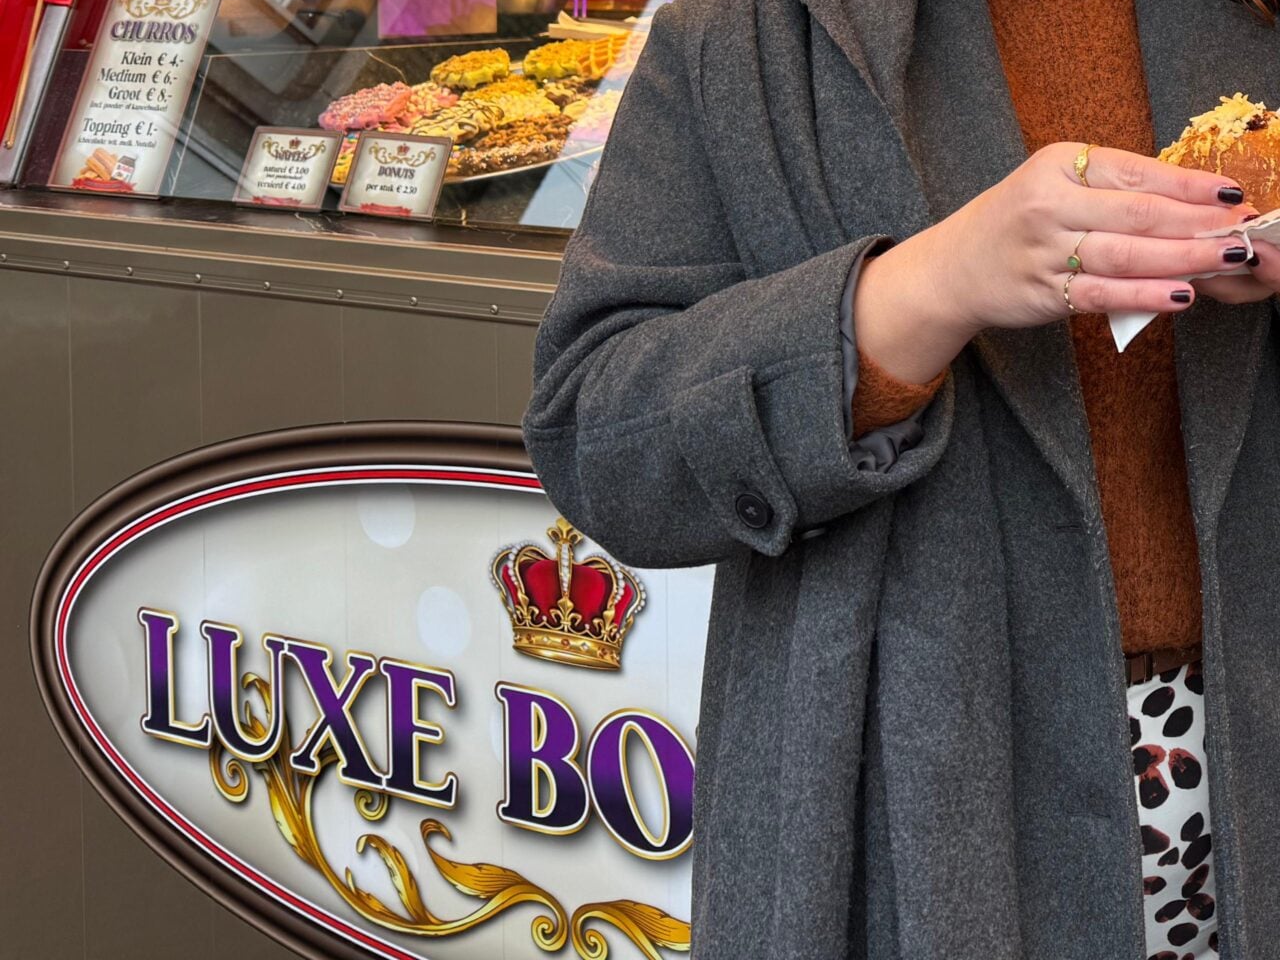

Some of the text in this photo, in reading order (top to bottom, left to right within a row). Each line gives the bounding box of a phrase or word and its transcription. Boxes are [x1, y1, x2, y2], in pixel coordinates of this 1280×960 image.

[110, 20, 199, 44] CHURROS
[120, 51, 152, 66] Klein
[157, 52, 168, 66] €
[98, 67, 147, 84] Medium
[151, 70, 162, 84] €
[108, 86, 142, 101] Groot
[146, 87, 156, 101] €
[82, 118, 132, 137] Topping
[135, 121, 145, 135] €
[377, 166, 416, 180] DONUTS
[365, 183, 378, 191] per
[378, 184, 394, 192] stuk
[396, 184, 402, 193] €
[137, 606, 457, 809] LUXE
